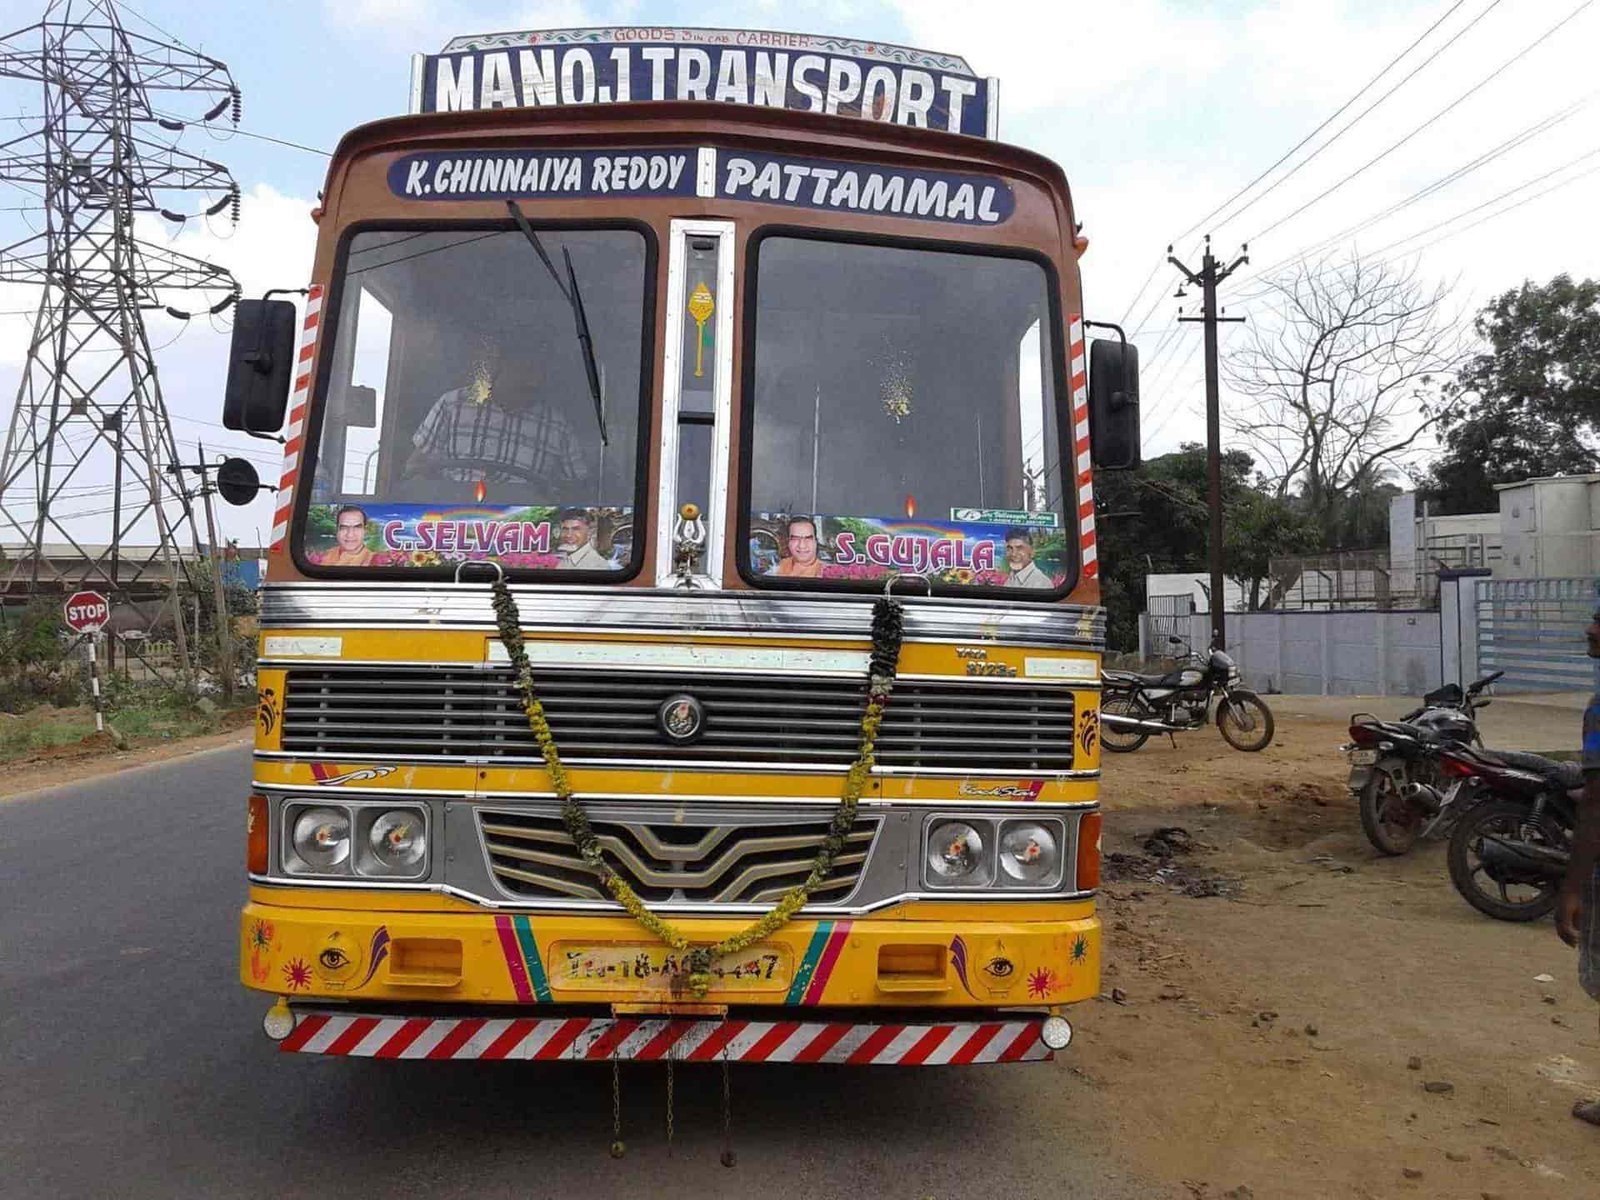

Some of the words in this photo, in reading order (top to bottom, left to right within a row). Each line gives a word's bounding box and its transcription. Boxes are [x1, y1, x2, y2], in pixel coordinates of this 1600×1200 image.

[613, 28, 676, 41] GOODS
[735, 31, 811, 47] CARRIER
[641, 46, 977, 135] TRANSPORT
[591, 154, 687, 193] REDDY
[724, 157, 1001, 223] PATTAMMAL
[69, 603, 106, 621] STOP
